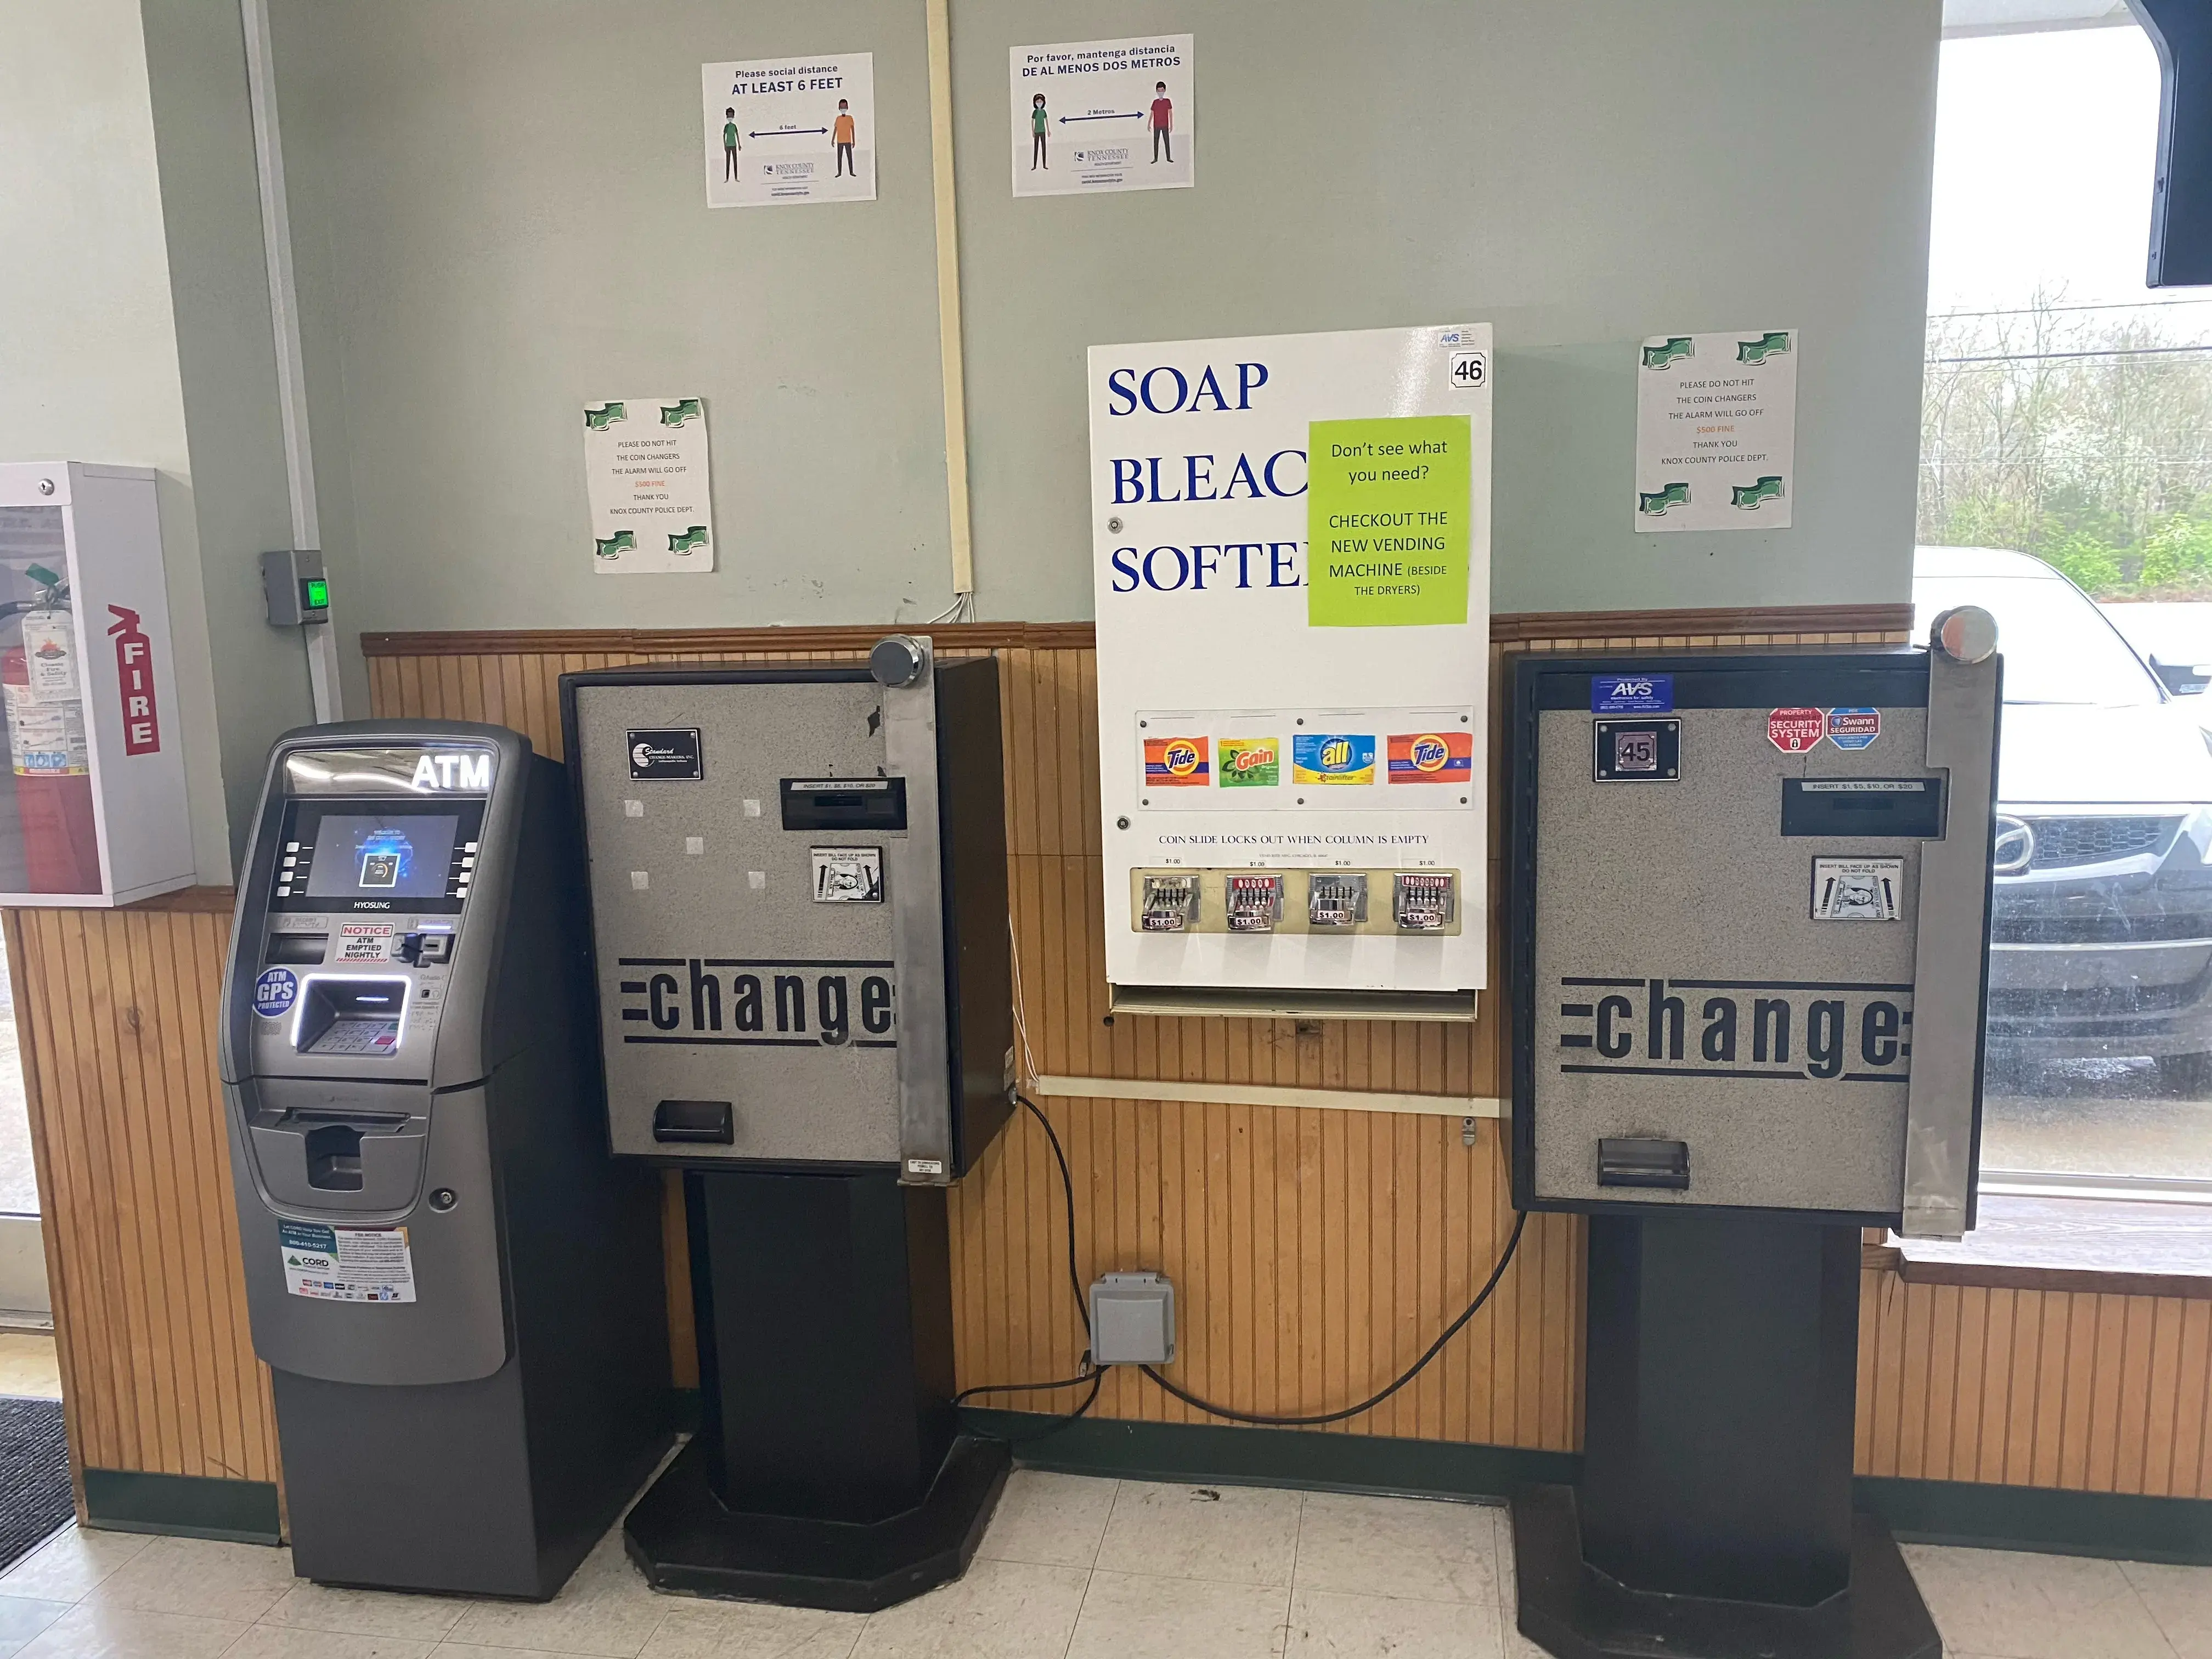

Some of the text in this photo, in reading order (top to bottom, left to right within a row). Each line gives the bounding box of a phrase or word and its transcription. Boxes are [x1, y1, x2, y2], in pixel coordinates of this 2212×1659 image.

[1046, 53, 1074, 62] favor,
[1077, 49, 1126, 60] mantenga
[1129, 44, 1175, 56] distancia
[735, 65, 838, 78] Please social distance
[1023, 57, 1181, 77] DE AL MENOS DOS METROS
[732, 77, 843, 95] AT LEAST 6 FEET
[1454, 360, 1482, 380] 46
[1108, 363, 1268, 416] SOAP
[1680, 381, 1707, 389] PLEASE
[1714, 394, 1757, 403] CHANGERS
[1696, 425, 1716, 434] $500
[1331, 440, 1448, 458] Don't see what
[1685, 456, 1717, 464] COUNTY
[1718, 455, 1745, 463] POLICE
[1747, 454, 1769, 462] DEPT.
[1110, 450, 1308, 505] BLEAC
[1348, 465, 1429, 484] you need?
[1329, 511, 1448, 529] CHECKOUT THE
[1331, 537, 1446, 554] NEW VENDING
[1111, 541, 1309, 592] SOFTE
[1329, 563, 1447, 578] MACHINE (BESIDE
[1355, 584, 1420, 596] THE DRYERS)
[124, 642, 153, 744] FIRE
[1611, 682, 1653, 696] AVS
[1770, 720, 1821, 729] SECURITY
[1843, 717, 1874, 725] Swann
[1771, 729, 1819, 738] SYSTEM
[645, 747, 674, 755] Standard
[1167, 749, 1195, 769] Tide
[1236, 750, 1274, 770] Gain
[1322, 741, 1349, 766] all
[1414, 744, 1446, 766] Tide
[1621, 742, 1650, 761] 45
[411, 755, 489, 787] ATM
[1159, 835, 1429, 844] COIN SLIDE LOCKS OUT WHEN COLUMN IS EMPTY
[343, 927, 391, 935] NOTICE
[267, 971, 287, 983] ATM
[257, 981, 294, 1002] GPS
[258, 1001, 290, 1009] PROTECTED
[650, 958, 891, 1046] change
[1596, 979, 1899, 1079] change
[302, 1257, 329, 1267] CORD
